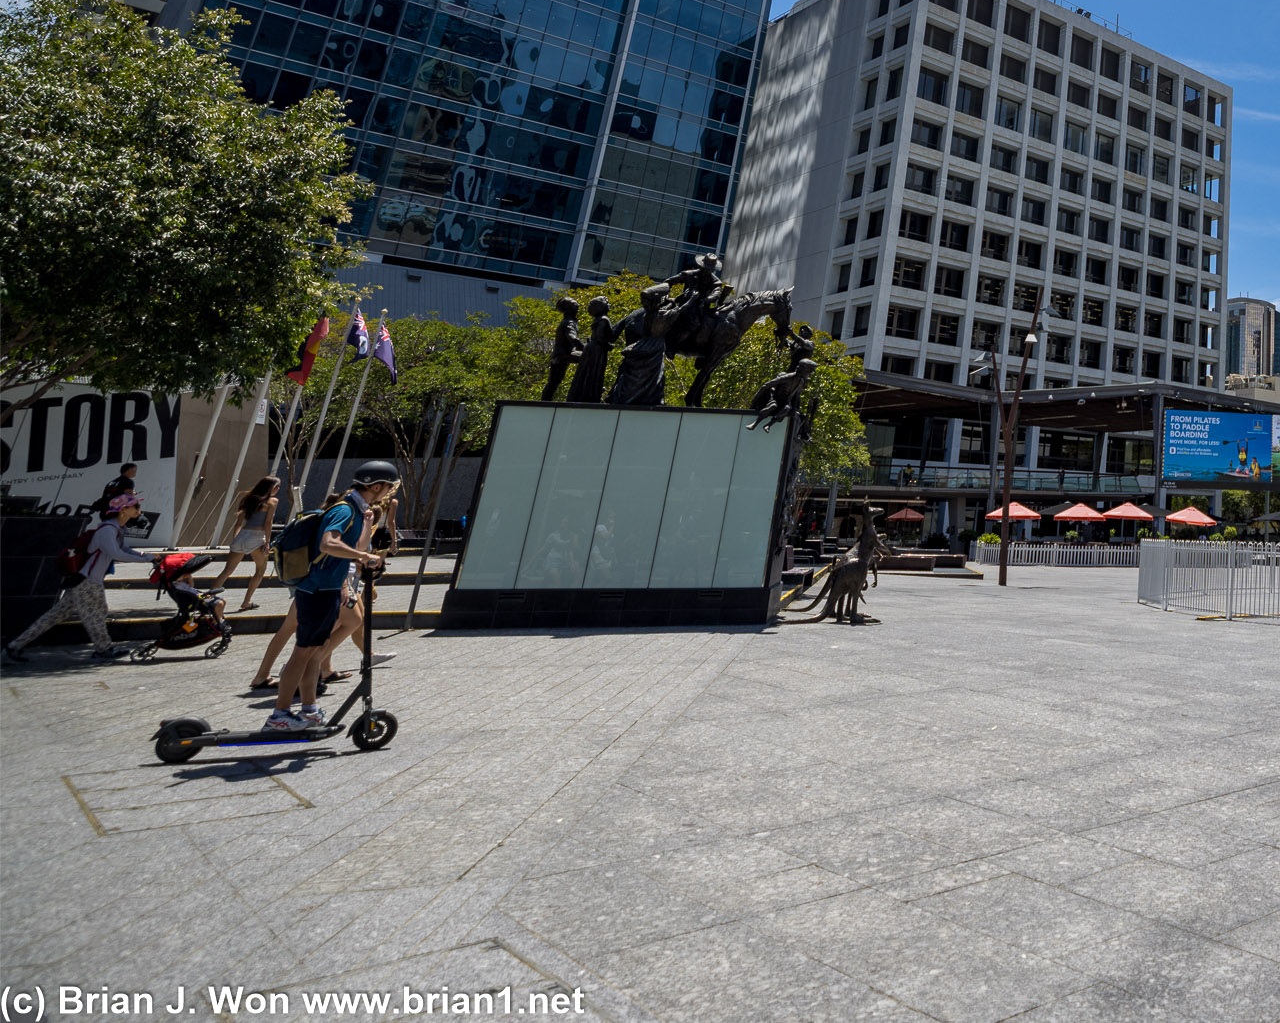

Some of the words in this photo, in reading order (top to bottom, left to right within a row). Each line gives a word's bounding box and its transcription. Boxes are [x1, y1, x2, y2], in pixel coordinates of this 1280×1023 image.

[1170, 415, 1192, 423] FROM
[1193, 416, 1221, 425] PILATES
[1182, 423, 1210, 432] PADDLE
[1169, 430, 1209, 439] BOARDING
